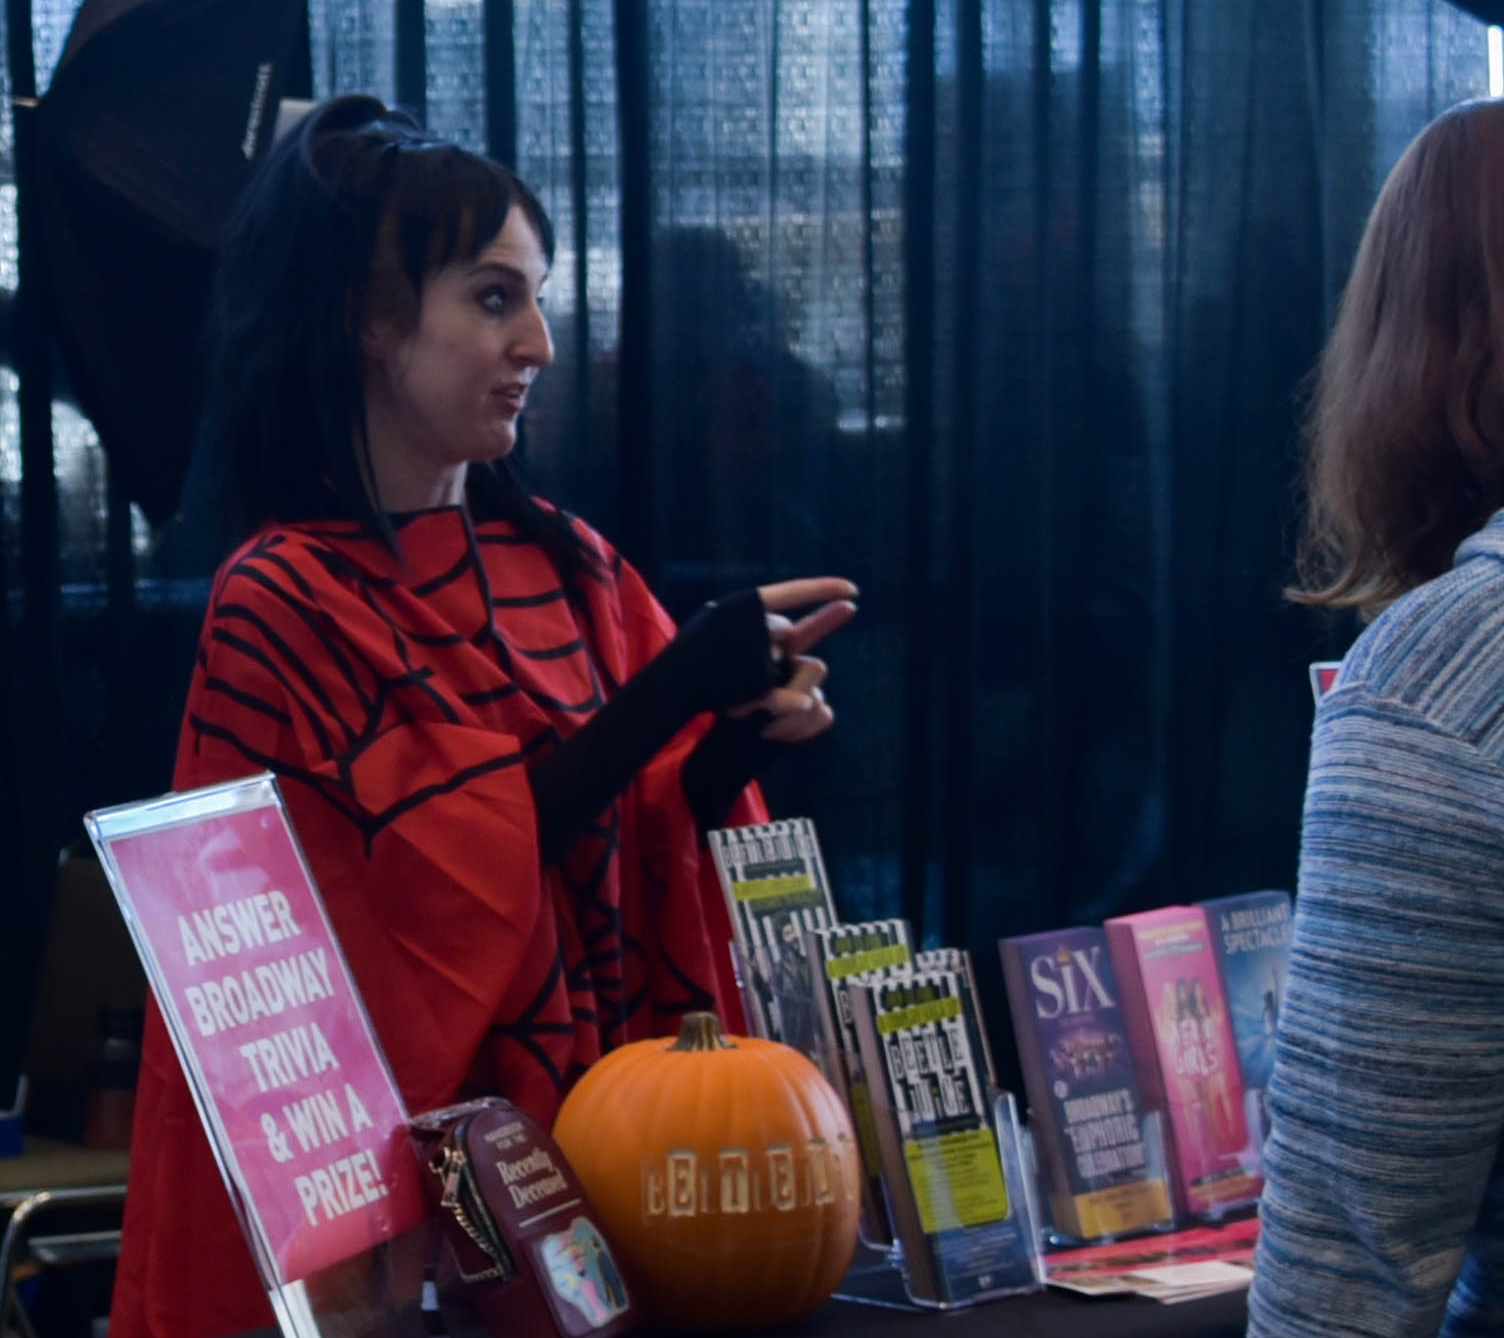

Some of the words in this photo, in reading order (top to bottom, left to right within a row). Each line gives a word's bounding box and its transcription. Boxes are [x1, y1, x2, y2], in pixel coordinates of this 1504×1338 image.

[177, 890, 300, 966] ANSWER
[184, 948, 336, 1037] BROADWAY
[240, 1023, 339, 1093] TRIVIA
[260, 1113, 288, 1163] &
[283, 1105, 345, 1155] WIN
[345, 1083, 374, 1130] A
[295, 1152, 389, 1227] PRIZE!
